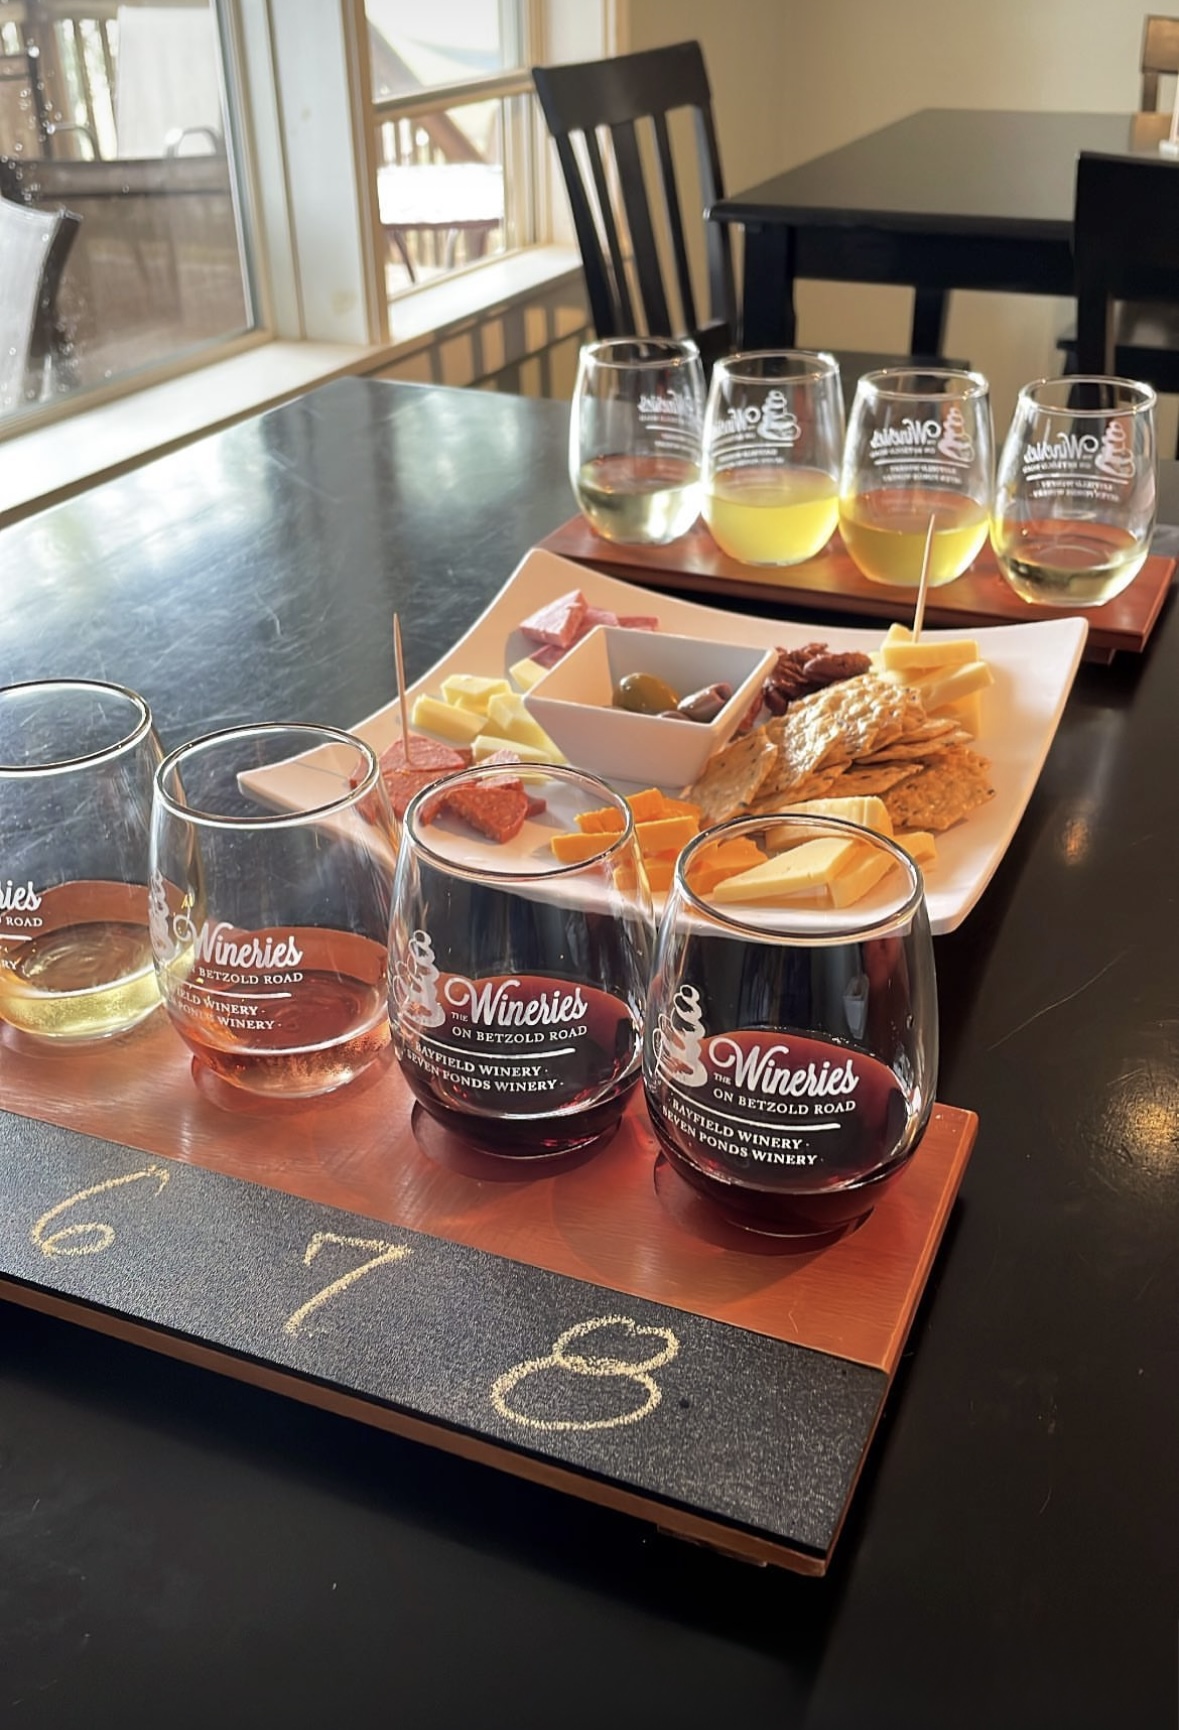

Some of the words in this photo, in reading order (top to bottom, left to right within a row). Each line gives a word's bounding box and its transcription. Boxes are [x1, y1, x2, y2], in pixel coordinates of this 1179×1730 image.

[6, 917, 43, 927] ROAD
[173, 915, 303, 968] Wineries
[199, 967, 259, 985] BETZOLD
[263, 972, 304, 985] ROAD
[203, 998, 259, 1015] WINERY
[444, 977, 588, 1027] Wineries
[450, 1012, 468, 1022] THE
[217, 1016, 275, 1030] WINERY
[452, 1026, 472, 1040] ON
[476, 1031, 545, 1044] BETZOLD
[549, 1025, 588, 1042] ROAD
[406, 1048, 439, 1076] SEVEN
[443, 1070, 491, 1090] PONDS
[494, 1079, 558, 1092] WINERY
[415, 1041, 475, 1073] BAYFIELD
[478, 1064, 542, 1077] WINERY
[708, 1037, 859, 1097] Wineries
[713, 1072, 731, 1086] THE
[713, 1088, 734, 1103] ON
[738, 1095, 809, 1115] BETZOLD
[814, 1100, 857, 1115] ROAD
[662, 1105, 696, 1138] SEVEN
[699, 1131, 749, 1158] PONDS
[751, 1149, 818, 1166] WINERY
[672, 1098, 735, 1138] BAYFIELD
[738, 1130, 803, 1150] WINERY
[31, 1163, 170, 1260] 6
[284, 1231, 413, 1337] 7
[490, 1315, 680, 1432] 8
